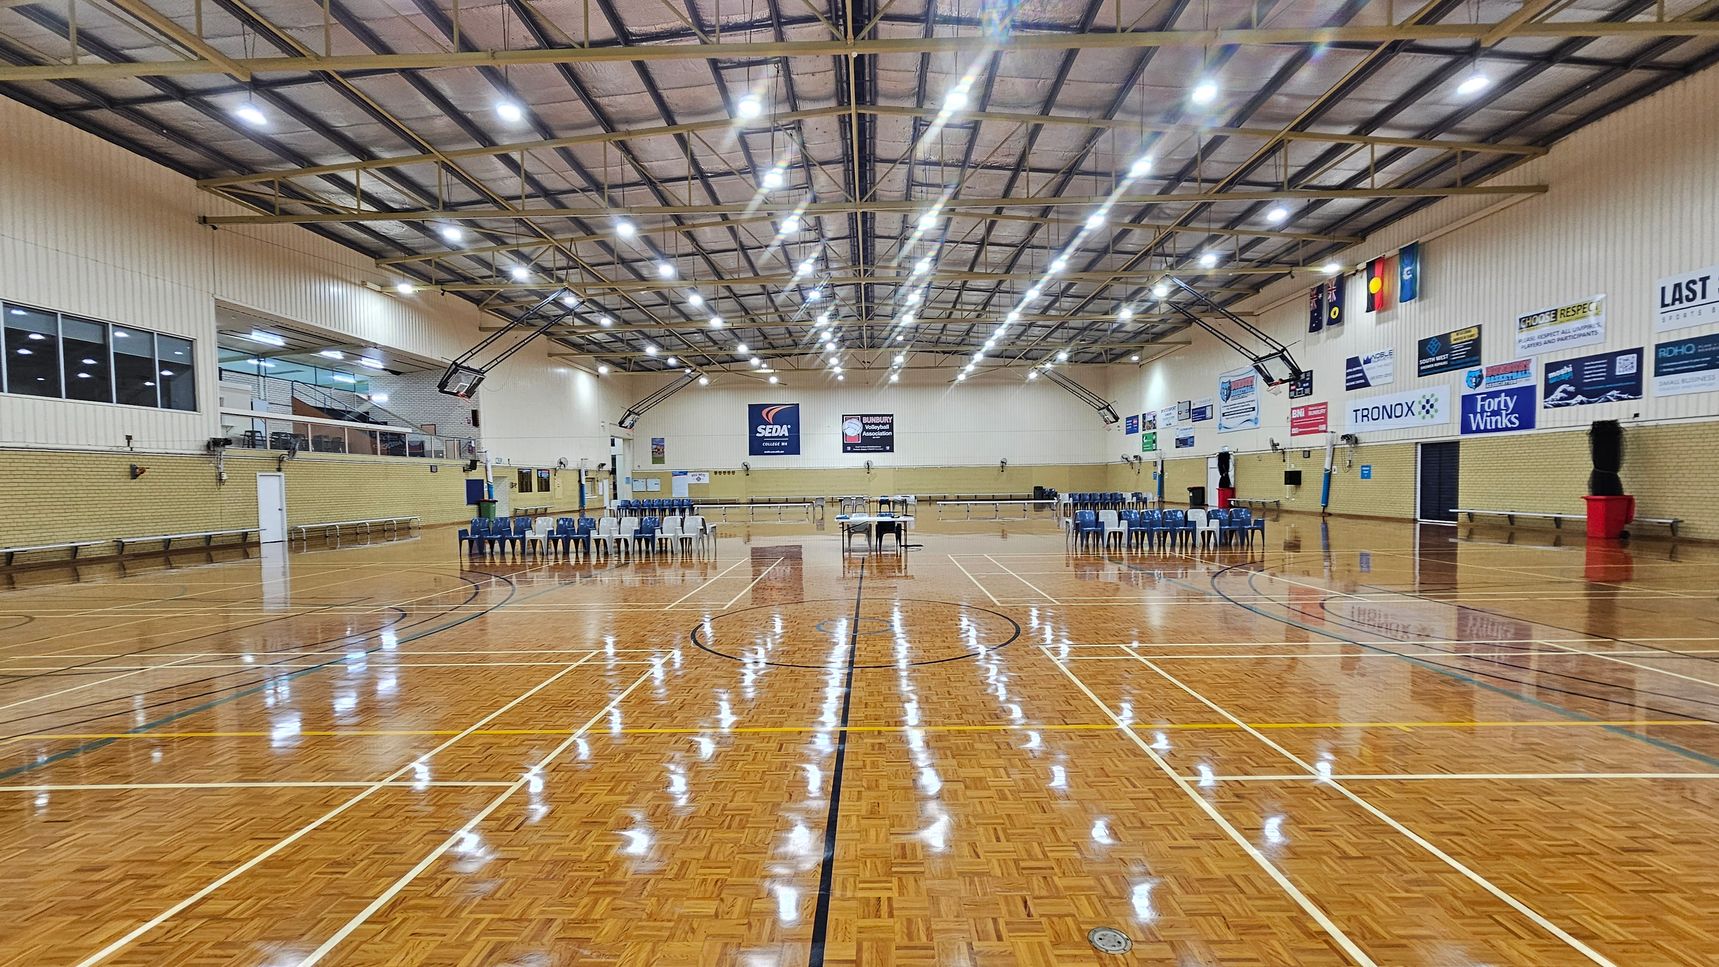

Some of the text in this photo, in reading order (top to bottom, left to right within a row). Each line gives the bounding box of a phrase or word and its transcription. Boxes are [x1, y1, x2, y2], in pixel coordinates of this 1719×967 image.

[1660, 275, 1711, 308] LAST
[1520, 310, 1557, 328] CHOOSE
[1543, 337, 1557, 345] AND
[1353, 400, 1415, 423] TRONOX
[1476, 392, 1517, 413] Forty
[862, 416, 893, 424] BUNBURY
[1468, 410, 1519, 431] Winks
[755, 424, 789, 437] SEDA
